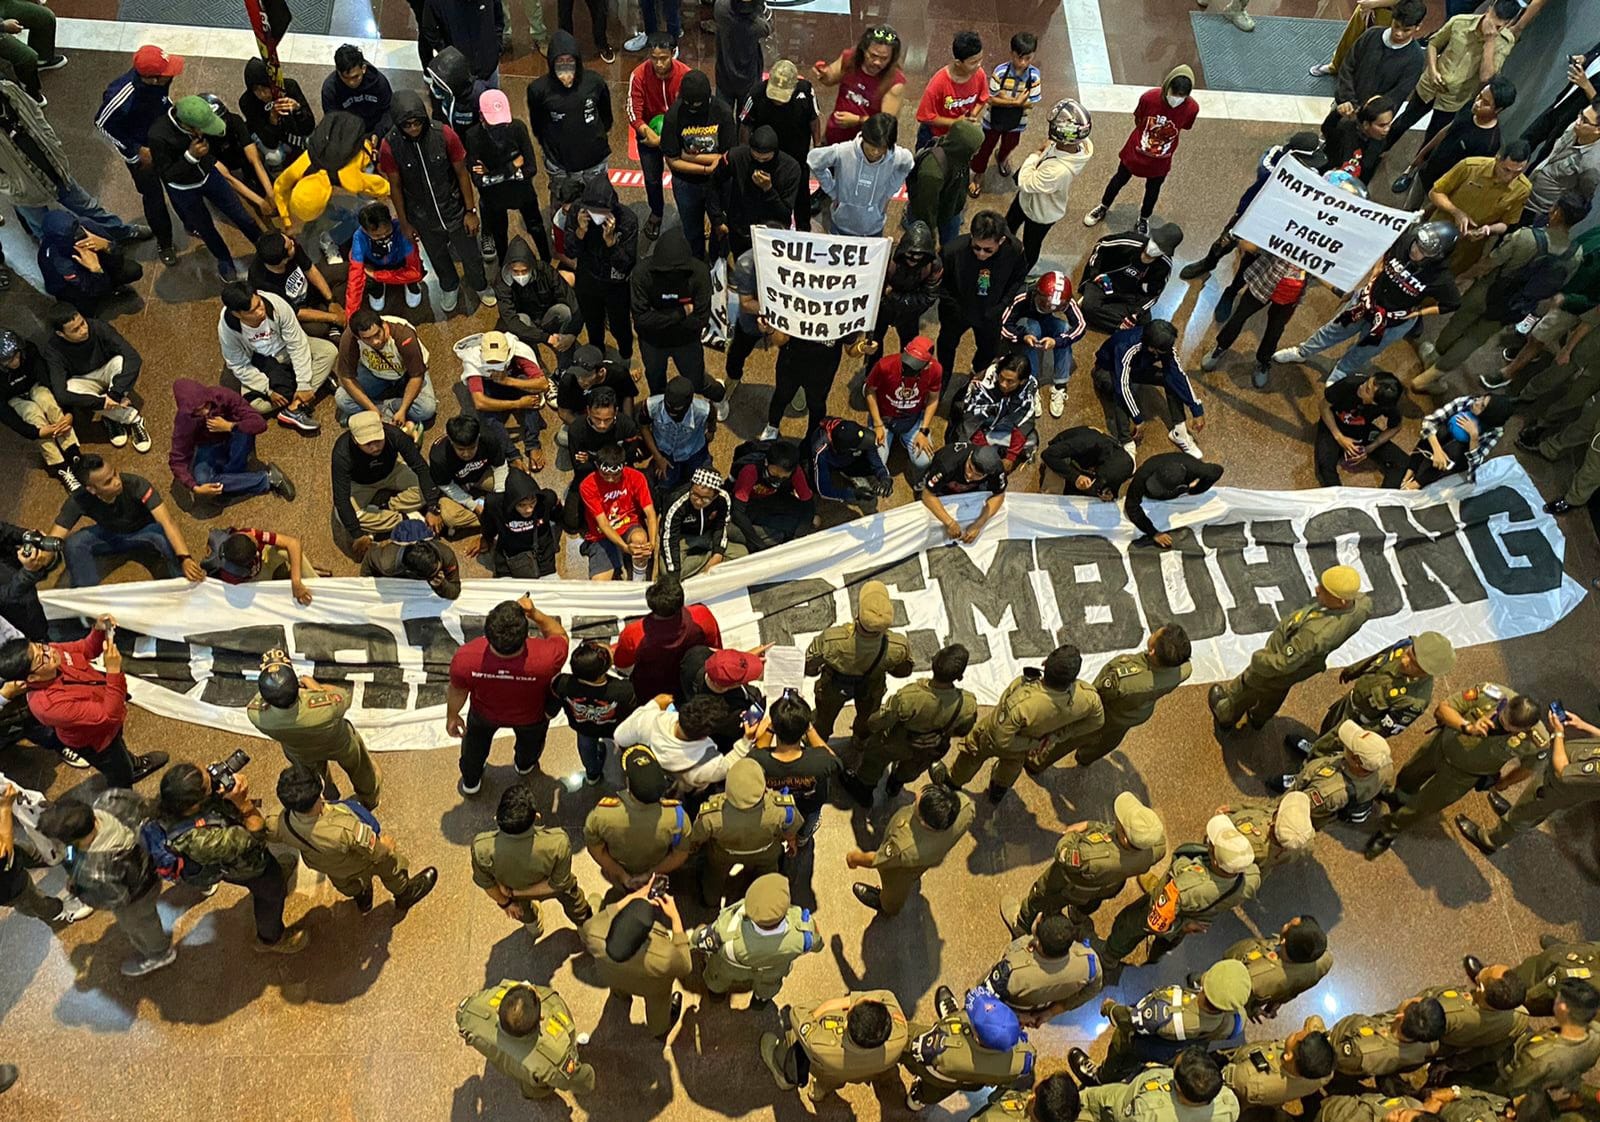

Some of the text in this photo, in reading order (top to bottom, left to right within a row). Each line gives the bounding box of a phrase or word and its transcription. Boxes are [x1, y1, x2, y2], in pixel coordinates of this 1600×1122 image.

[1276, 167, 1408, 232] MATTOANGING
[771, 239, 870, 267] SUL-SEL
[1284, 219, 1344, 254] PAGUB
[1268, 234, 1336, 275] WALKOT
[777, 266, 857, 290] TANPA
[1388, 257, 1427, 293] NORTH
[766, 286, 870, 316] STADION
[764, 306, 866, 338] HA HA HA
